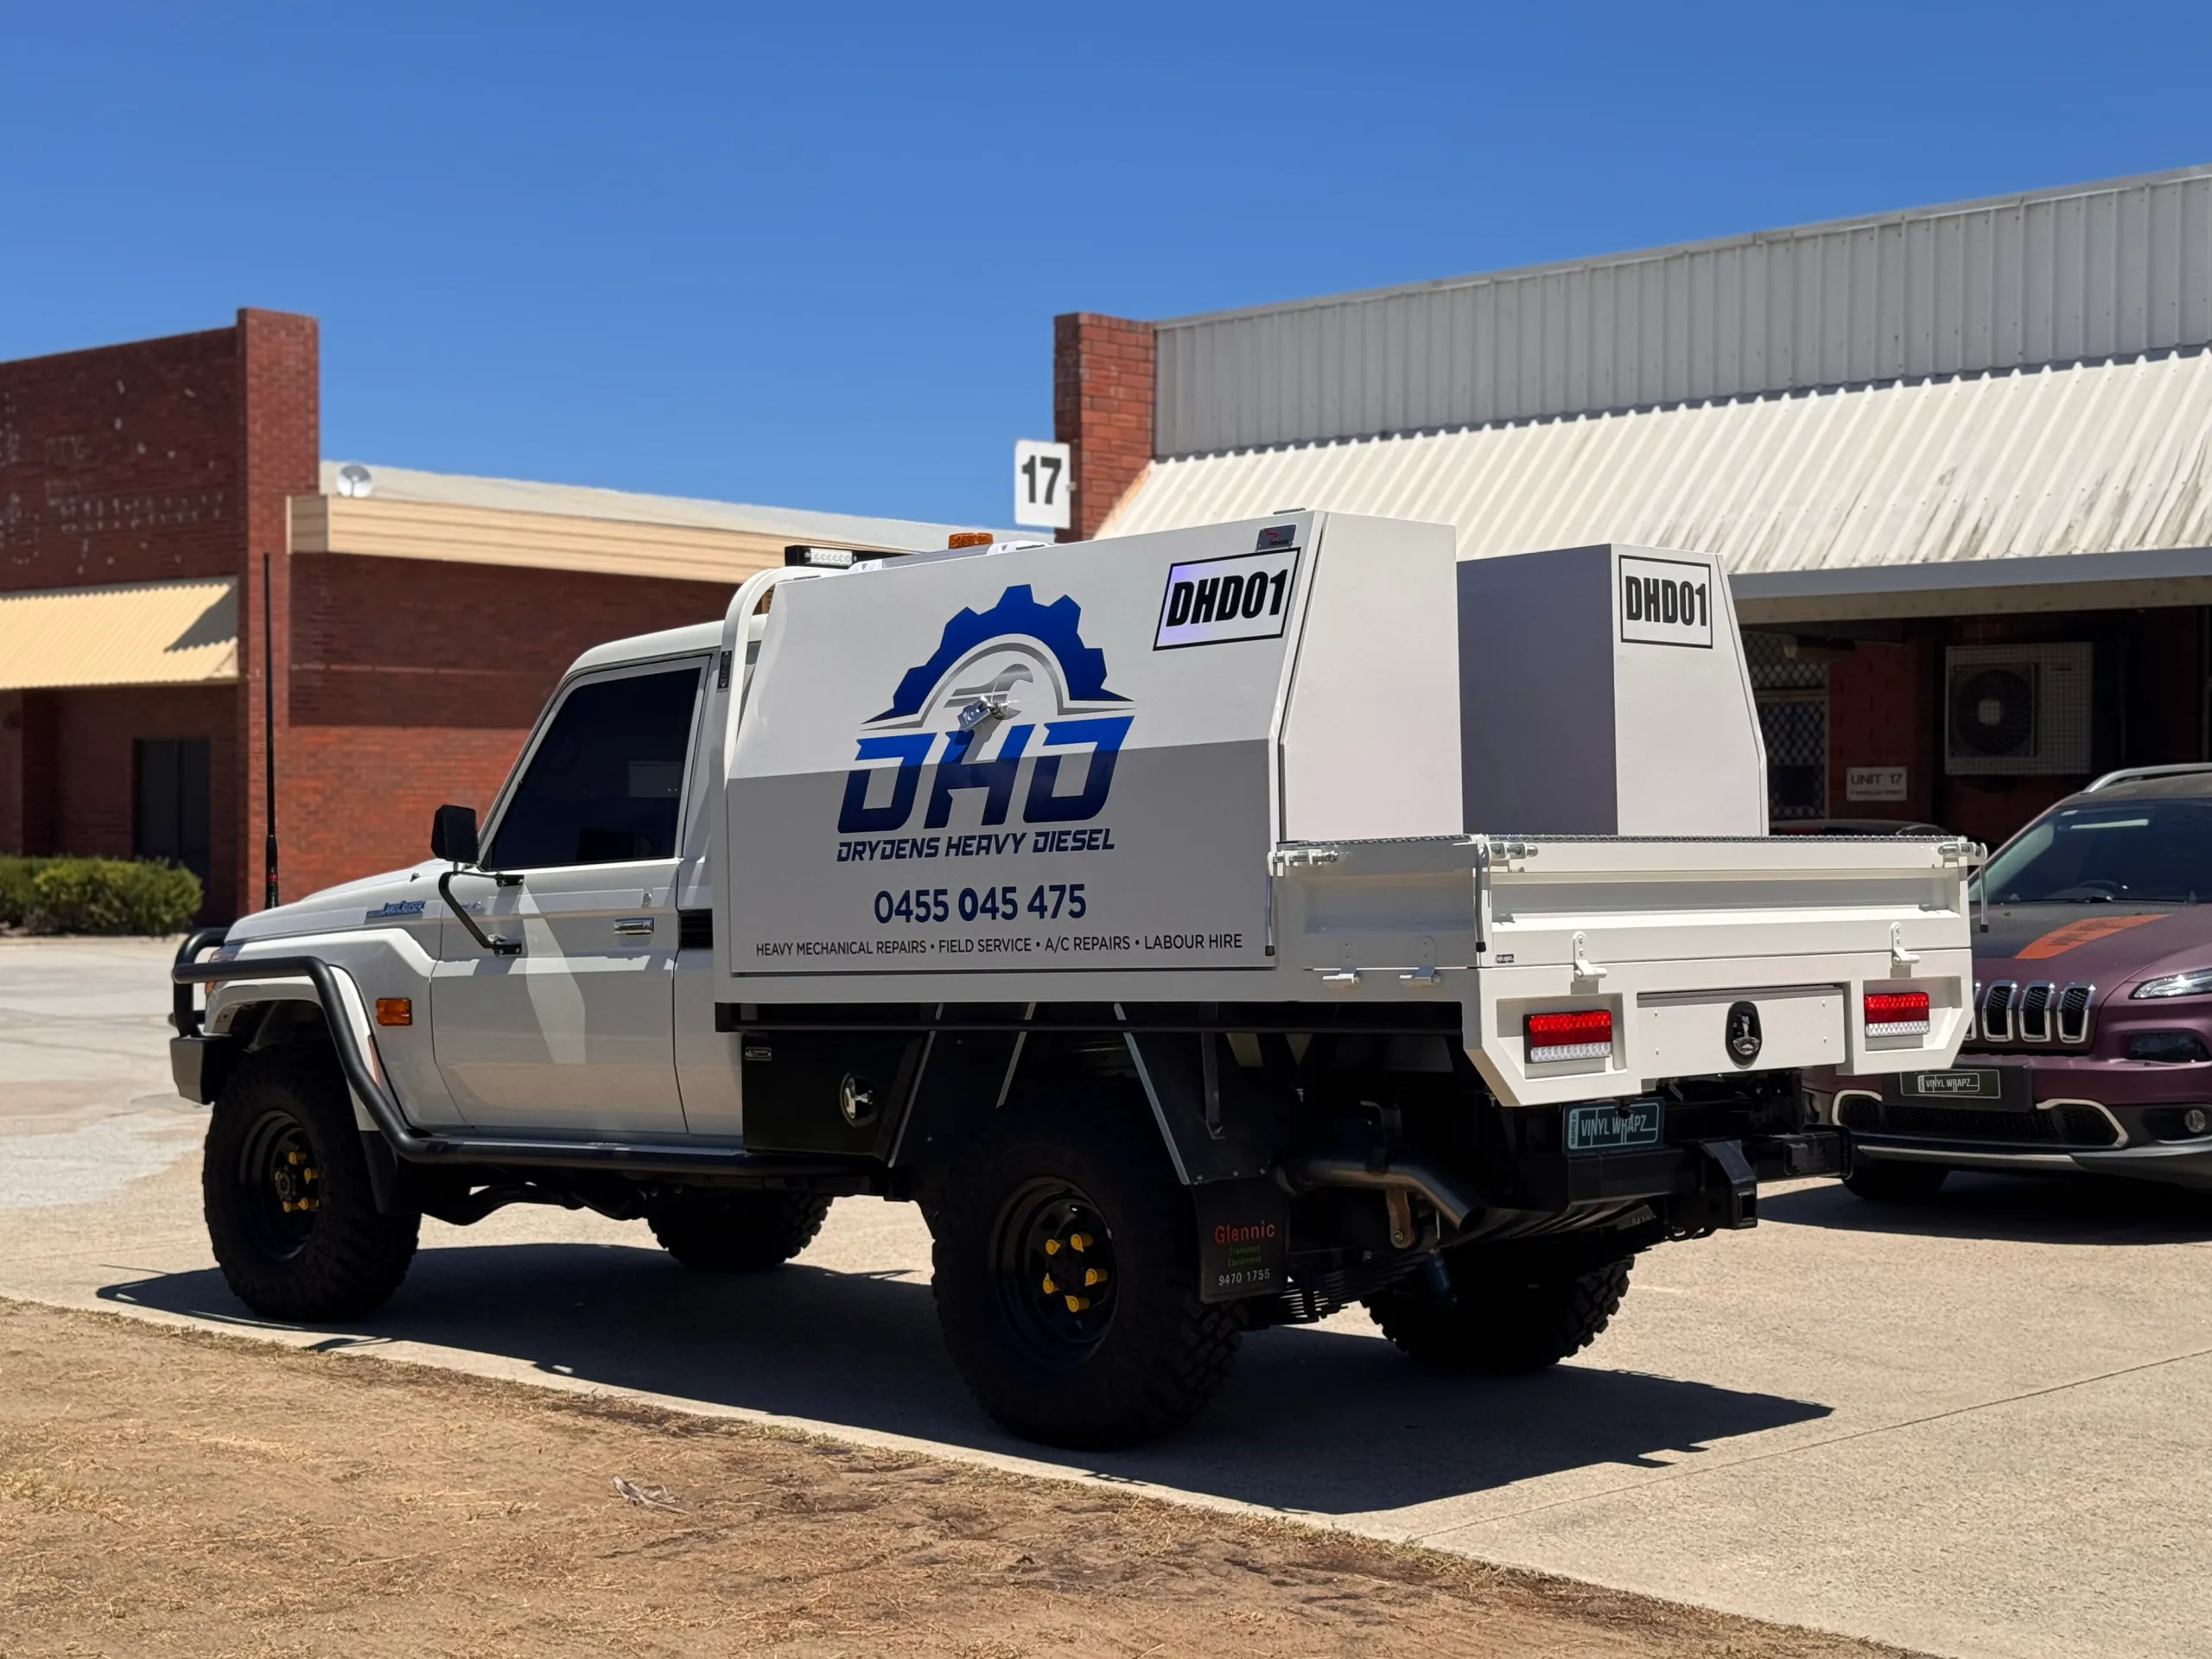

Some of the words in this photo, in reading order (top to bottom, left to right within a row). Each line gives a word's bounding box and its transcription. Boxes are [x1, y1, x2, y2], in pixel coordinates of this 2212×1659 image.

[1021, 454, 1062, 505] 17
[1166, 569, 1288, 627] DHD01
[1625, 575, 1707, 626] DHD01
[837, 715, 1135, 834] DHD
[1851, 773, 1882, 785] UNIT
[1889, 772, 1904, 785] 17
[836, 837, 941, 862] DRYDENS
[944, 832, 1027, 857] HEAVY
[1032, 828, 1116, 854] DIESEL
[874, 888, 950, 924] 0455
[958, 887, 1018, 922] 045
[1027, 883, 1087, 919] 475
[756, 943, 794, 956] HEAVY
[797, 941, 874, 956] MECHANICAL
[876, 940, 927, 954] REPAIRS
[938, 939, 975, 953] FIELD
[977, 938, 1033, 952] SERVICE
[1045, 935, 1071, 953] A/C
[1073, 936, 1131, 950] REPAIRS
[1144, 934, 1205, 950] LABOUR
[1209, 933, 1243, 949] HIRE
[1925, 1077, 1946, 1089] VINYL
[1946, 1077, 1971, 1088] WRAPZ
[1580, 1117, 1611, 1137] VINYL
[1214, 1220, 1276, 1245] Glennic
[1218, 1272, 1243, 1287] 9470
[1246, 1268, 1271, 1283] 1755
